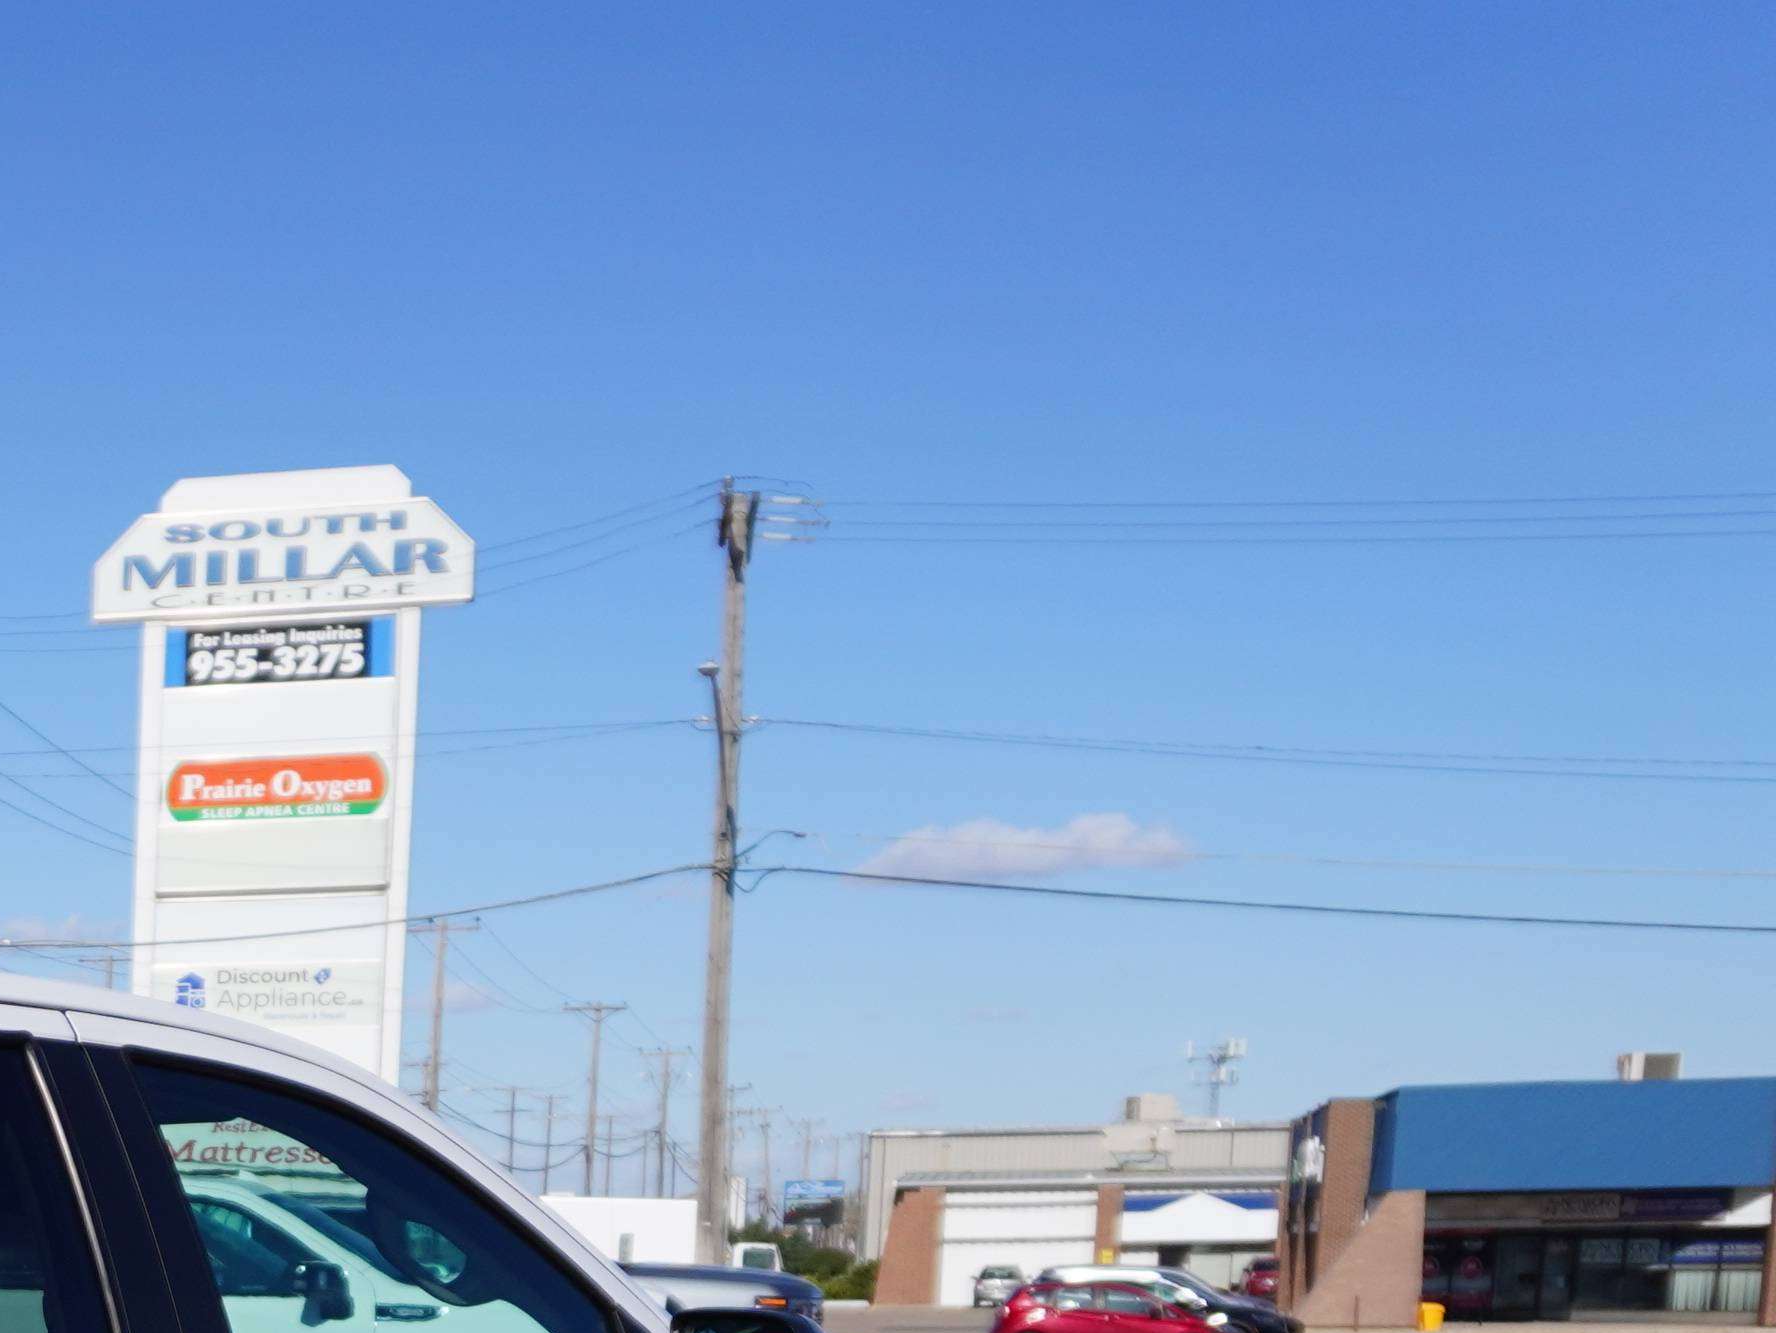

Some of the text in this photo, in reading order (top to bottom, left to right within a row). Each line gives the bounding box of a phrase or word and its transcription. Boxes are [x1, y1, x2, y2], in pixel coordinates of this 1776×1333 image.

[164, 510, 407, 543] SOUTH
[122, 537, 450, 591] MILLAR
[193, 624, 363, 649] For Leasing Inquiries
[188, 642, 365, 681] 955-3275
[179, 769, 373, 801] Prairie Oxygen
[200, 802, 351, 819] SLEEP APNEA CENTRE
[216, 967, 309, 985] Discount
